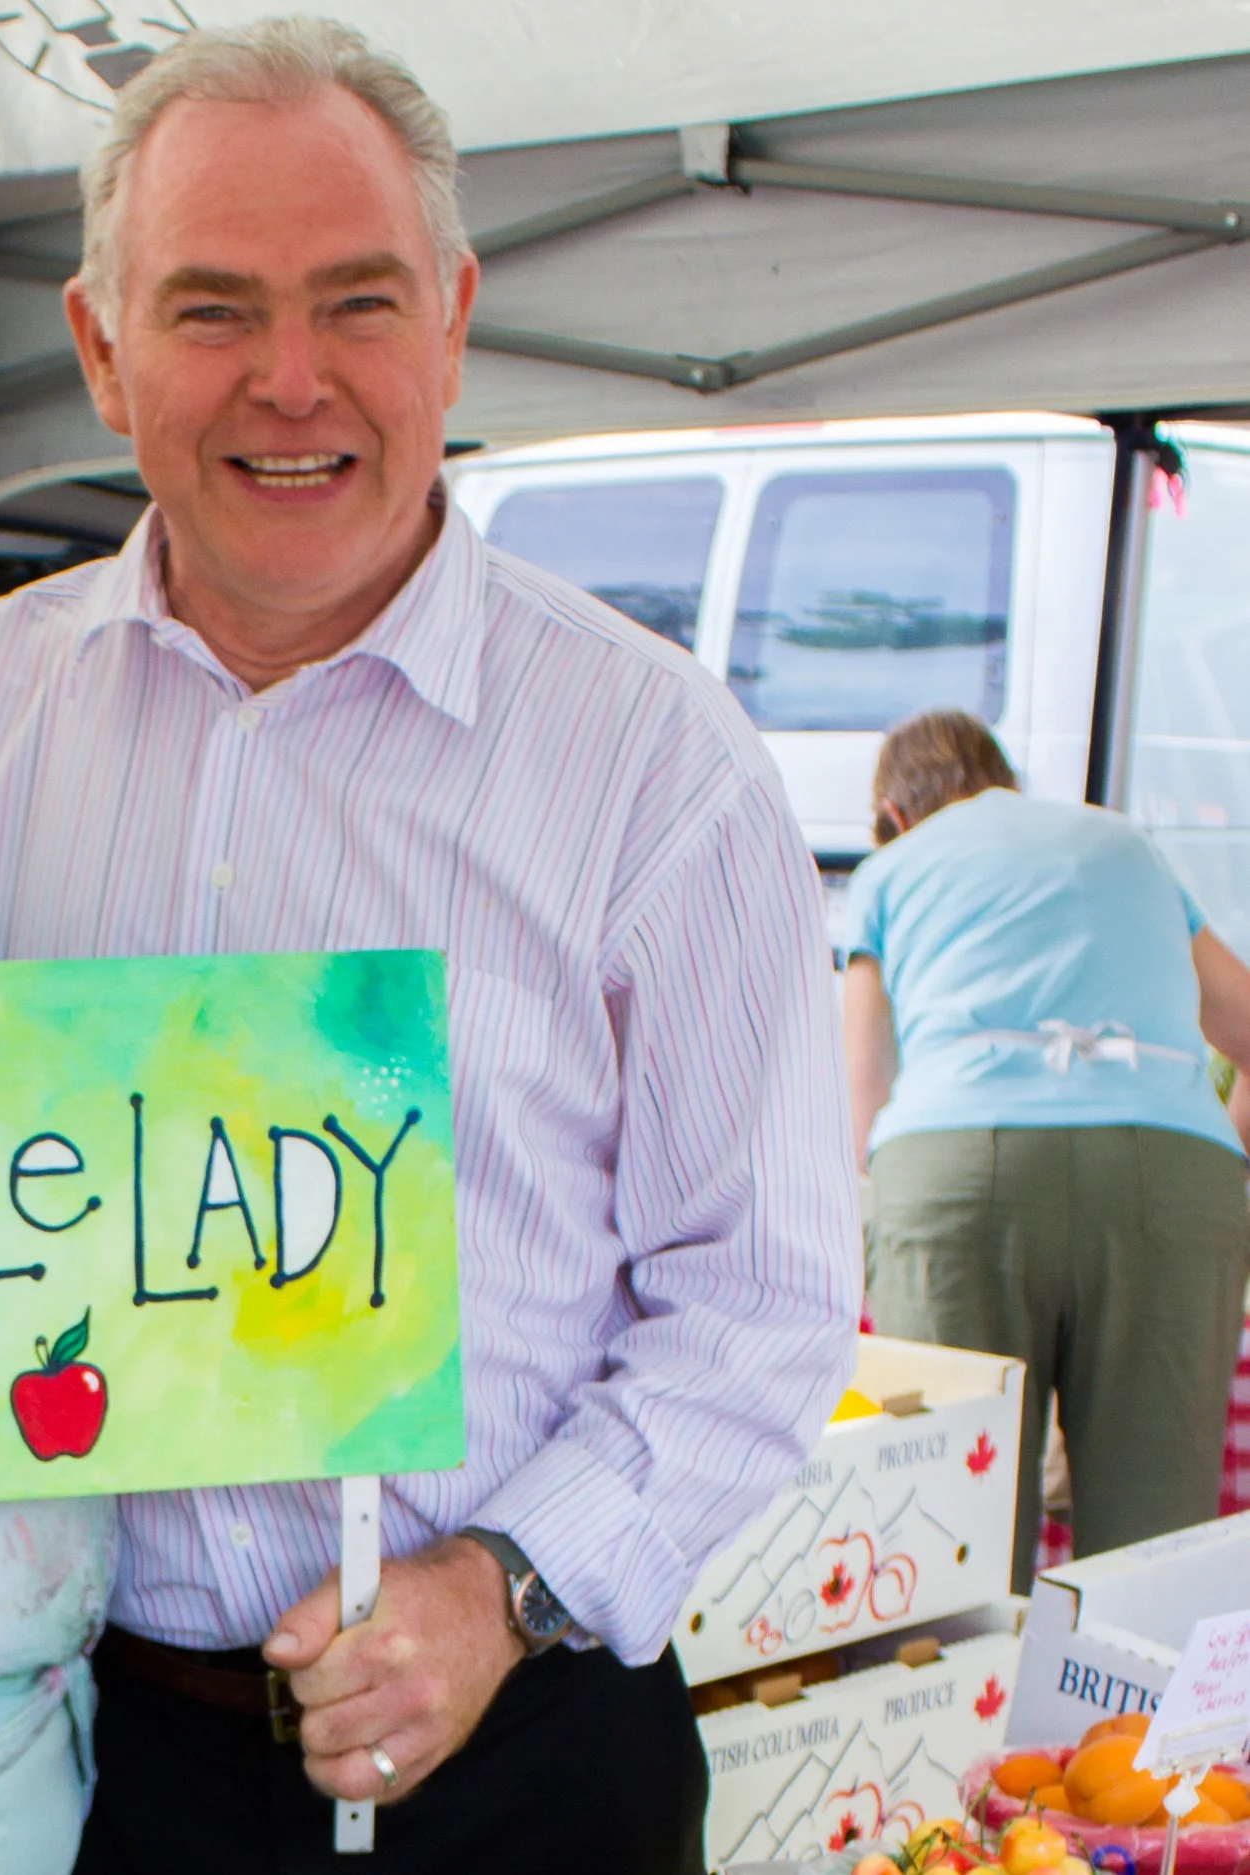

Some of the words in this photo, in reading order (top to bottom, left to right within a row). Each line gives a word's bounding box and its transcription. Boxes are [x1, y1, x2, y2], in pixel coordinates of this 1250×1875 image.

[129, 1093, 422, 1308] LADY
[792, 1459, 834, 1491] MBIA
[877, 1431, 949, 1473] PRODUCE
[1057, 1657, 1163, 1715] BRITIS
[711, 1741, 749, 1774] TISH
[753, 1718, 840, 1761] COLUMBIA
[884, 1680, 957, 1724] PRODUCE
